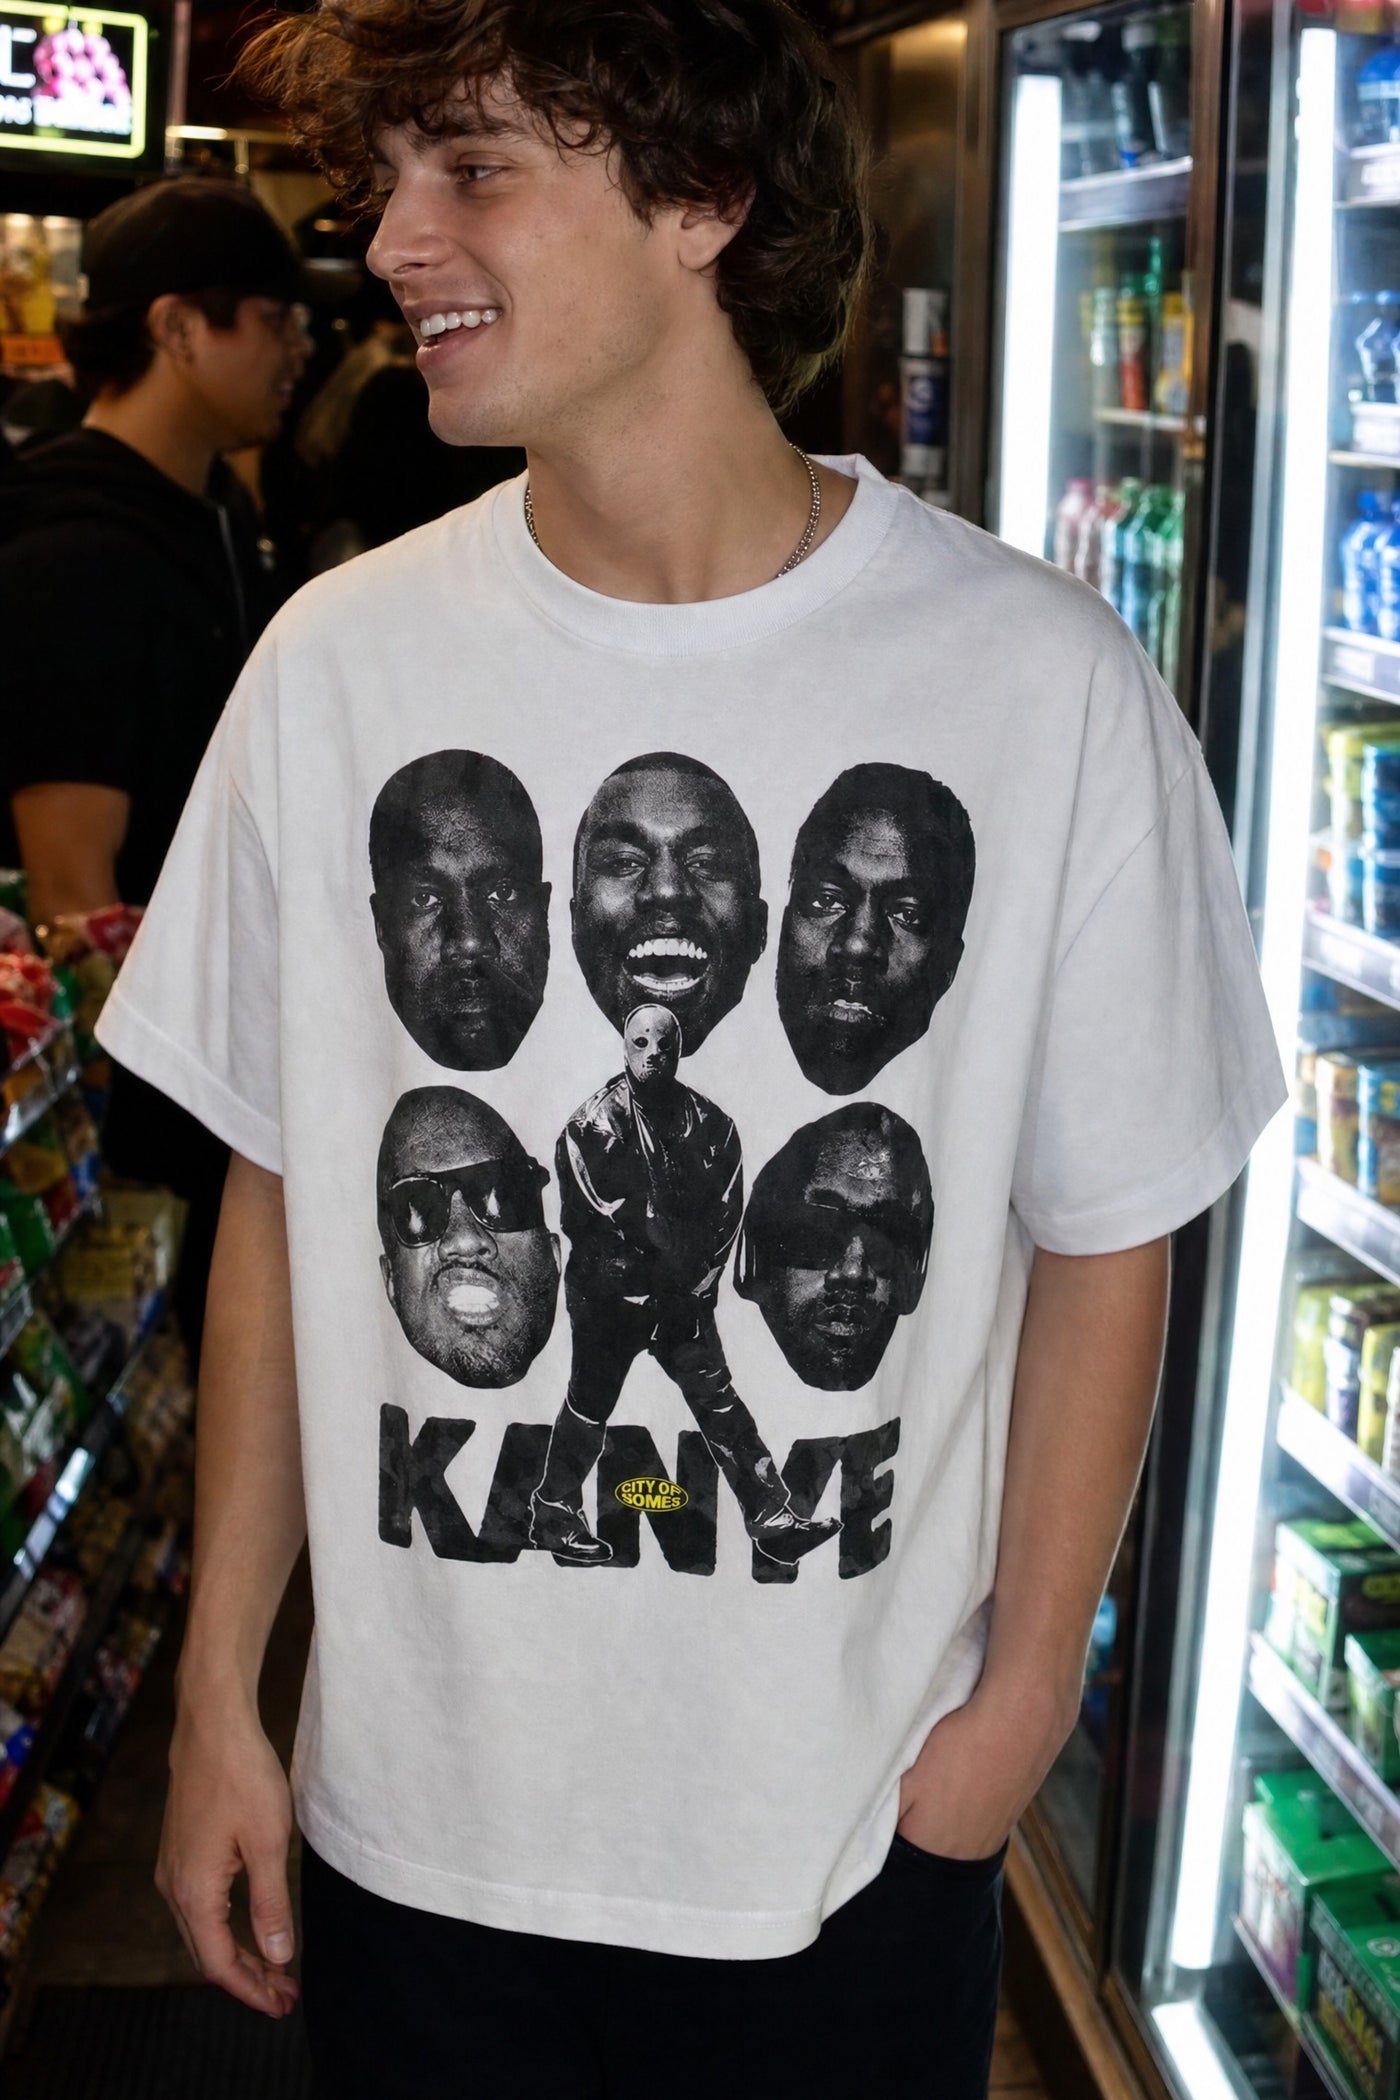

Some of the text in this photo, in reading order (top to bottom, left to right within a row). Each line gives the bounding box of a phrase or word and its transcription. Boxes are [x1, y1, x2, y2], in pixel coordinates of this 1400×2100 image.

[621, 1480, 681, 1496] CITY OF
[621, 1493, 681, 1509] SOMES
